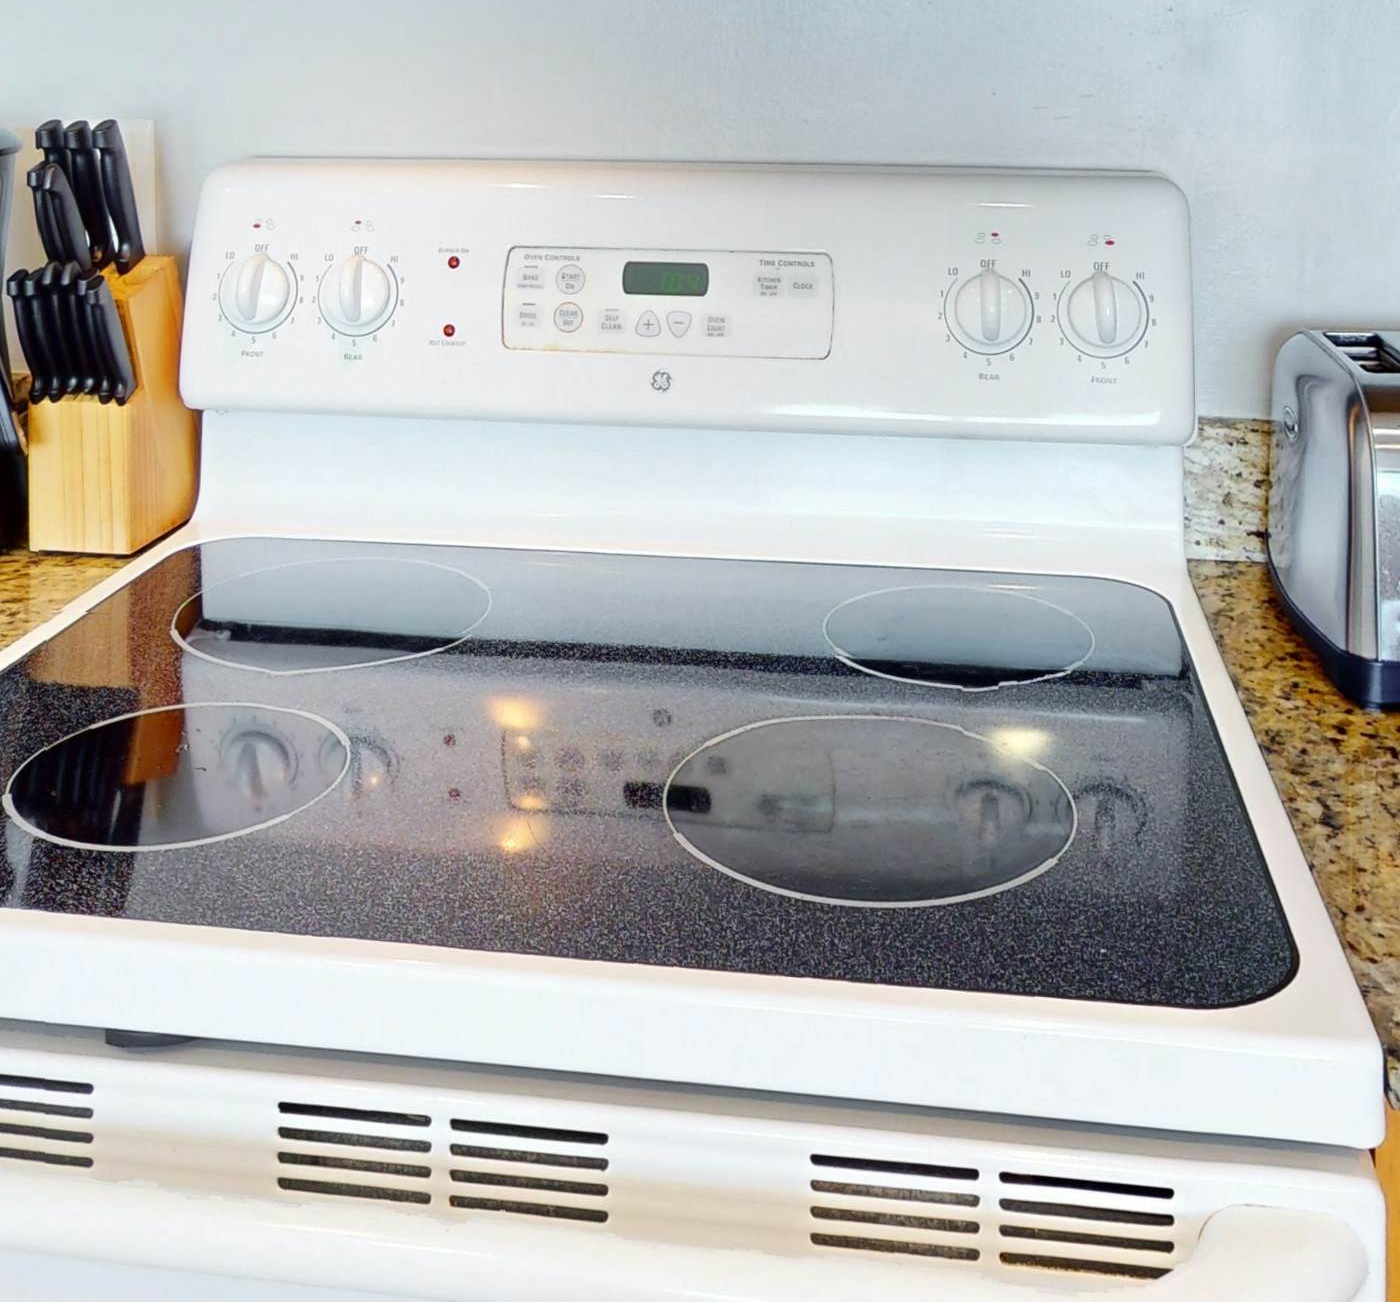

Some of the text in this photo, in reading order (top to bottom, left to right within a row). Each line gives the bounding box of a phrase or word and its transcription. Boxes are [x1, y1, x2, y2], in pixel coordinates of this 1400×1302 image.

[254, 244, 270, 253] OFF
[354, 246, 369, 255] OFF
[225, 252, 235, 260] LO
[290, 253, 299, 261] HI
[324, 253, 334, 262] LO
[390, 255, 399, 263] HI
[544, 254, 581, 262] CONTROLS
[777, 259, 816, 268] CONTROLS
[980, 259, 997, 269] OFF
[1093, 261, 1110, 271] OFF
[948, 267, 959, 276] LO
[1022, 269, 1031, 277] HI
[1060, 270, 1071, 279] LO
[1136, 271, 1145, 280] HI
[792, 282, 814, 290] CLOCK
[978, 372, 1000, 381] REAR
